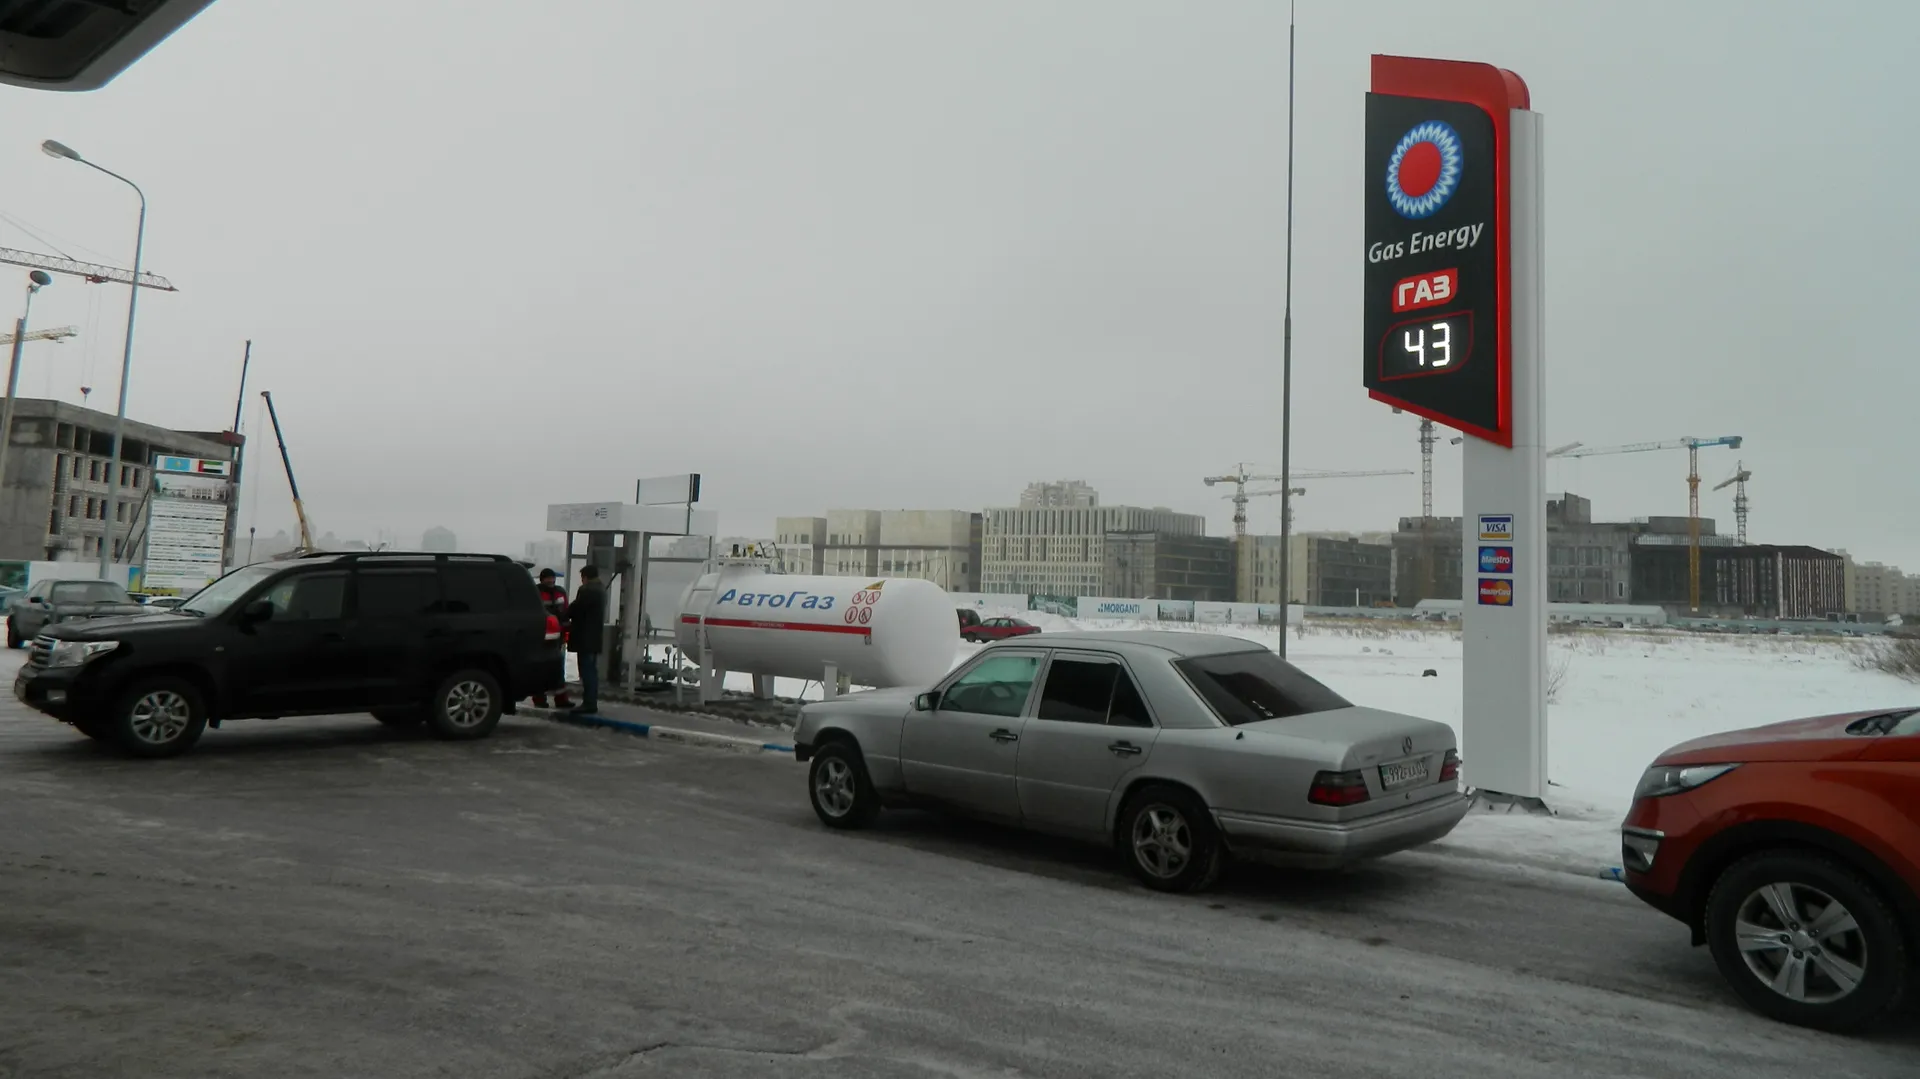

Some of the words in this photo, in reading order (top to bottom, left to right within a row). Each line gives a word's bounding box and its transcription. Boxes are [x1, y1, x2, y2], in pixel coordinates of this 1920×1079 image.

[1368, 241, 1404, 263] Gas
[1410, 222, 1484, 255] Energy
[1399, 275, 1450, 306] ГАЗ
[1404, 322, 1450, 367] 43
[1486, 523, 1506, 532] VISA
[1481, 556, 1510, 564] Maestro
[716, 588, 835, 610] АвтоГаз
[1104, 603, 1140, 614] MORGANTI
